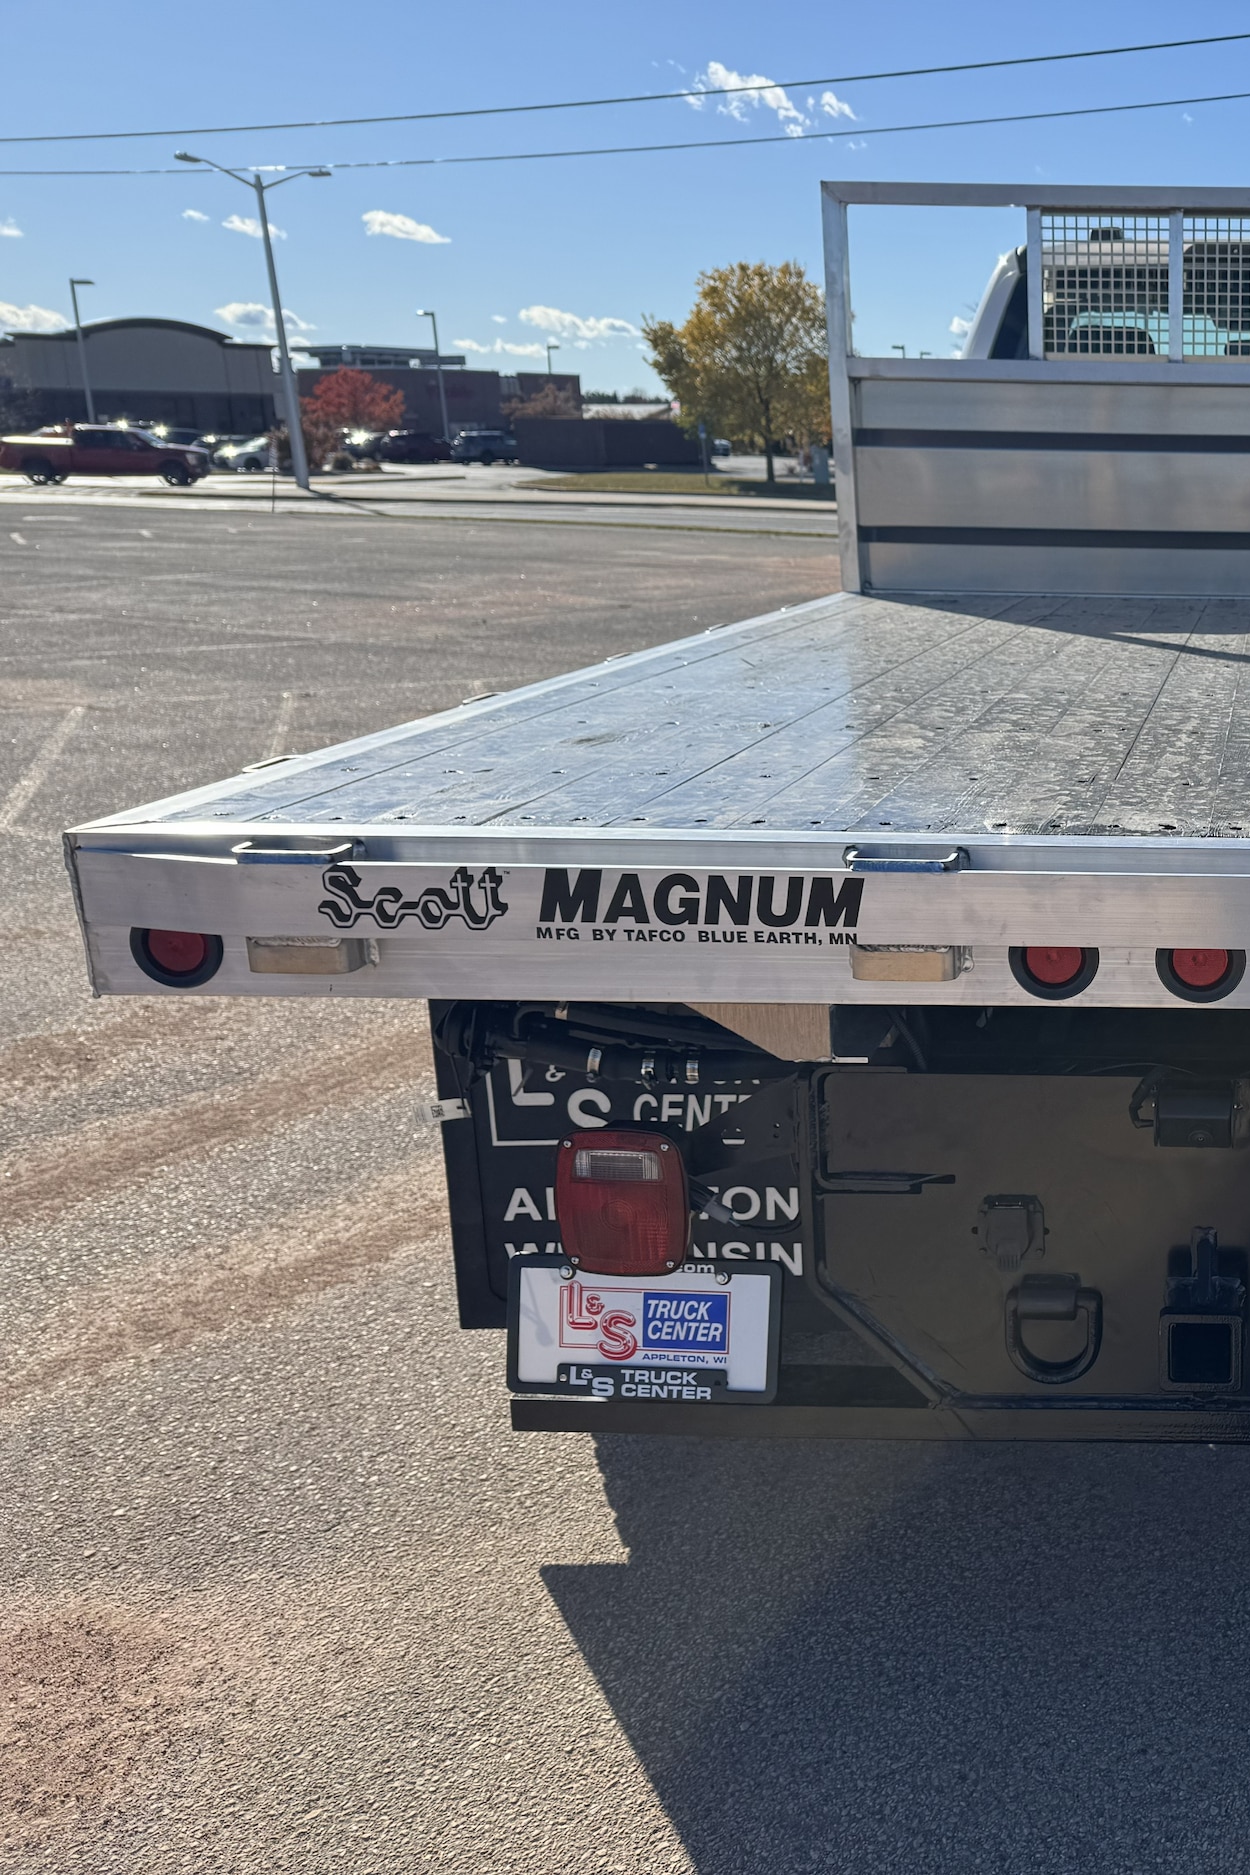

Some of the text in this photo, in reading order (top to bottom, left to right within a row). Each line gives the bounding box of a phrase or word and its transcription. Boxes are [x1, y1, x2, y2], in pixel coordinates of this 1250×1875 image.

[318, 865, 508, 930] Scott
[539, 868, 865, 928] MAGNUM
[536, 927, 858, 945] MFG BY TAFCO BLUE EARTH, MN
[633, 1094, 752, 1132] CENT
[647, 1299, 713, 1321] TRUCK
[647, 1322, 723, 1342] CENTER
[642, 1353, 727, 1365] APPLETON, WI
[621, 1369, 697, 1385] TRUCK
[621, 1383, 711, 1400] CENTER
